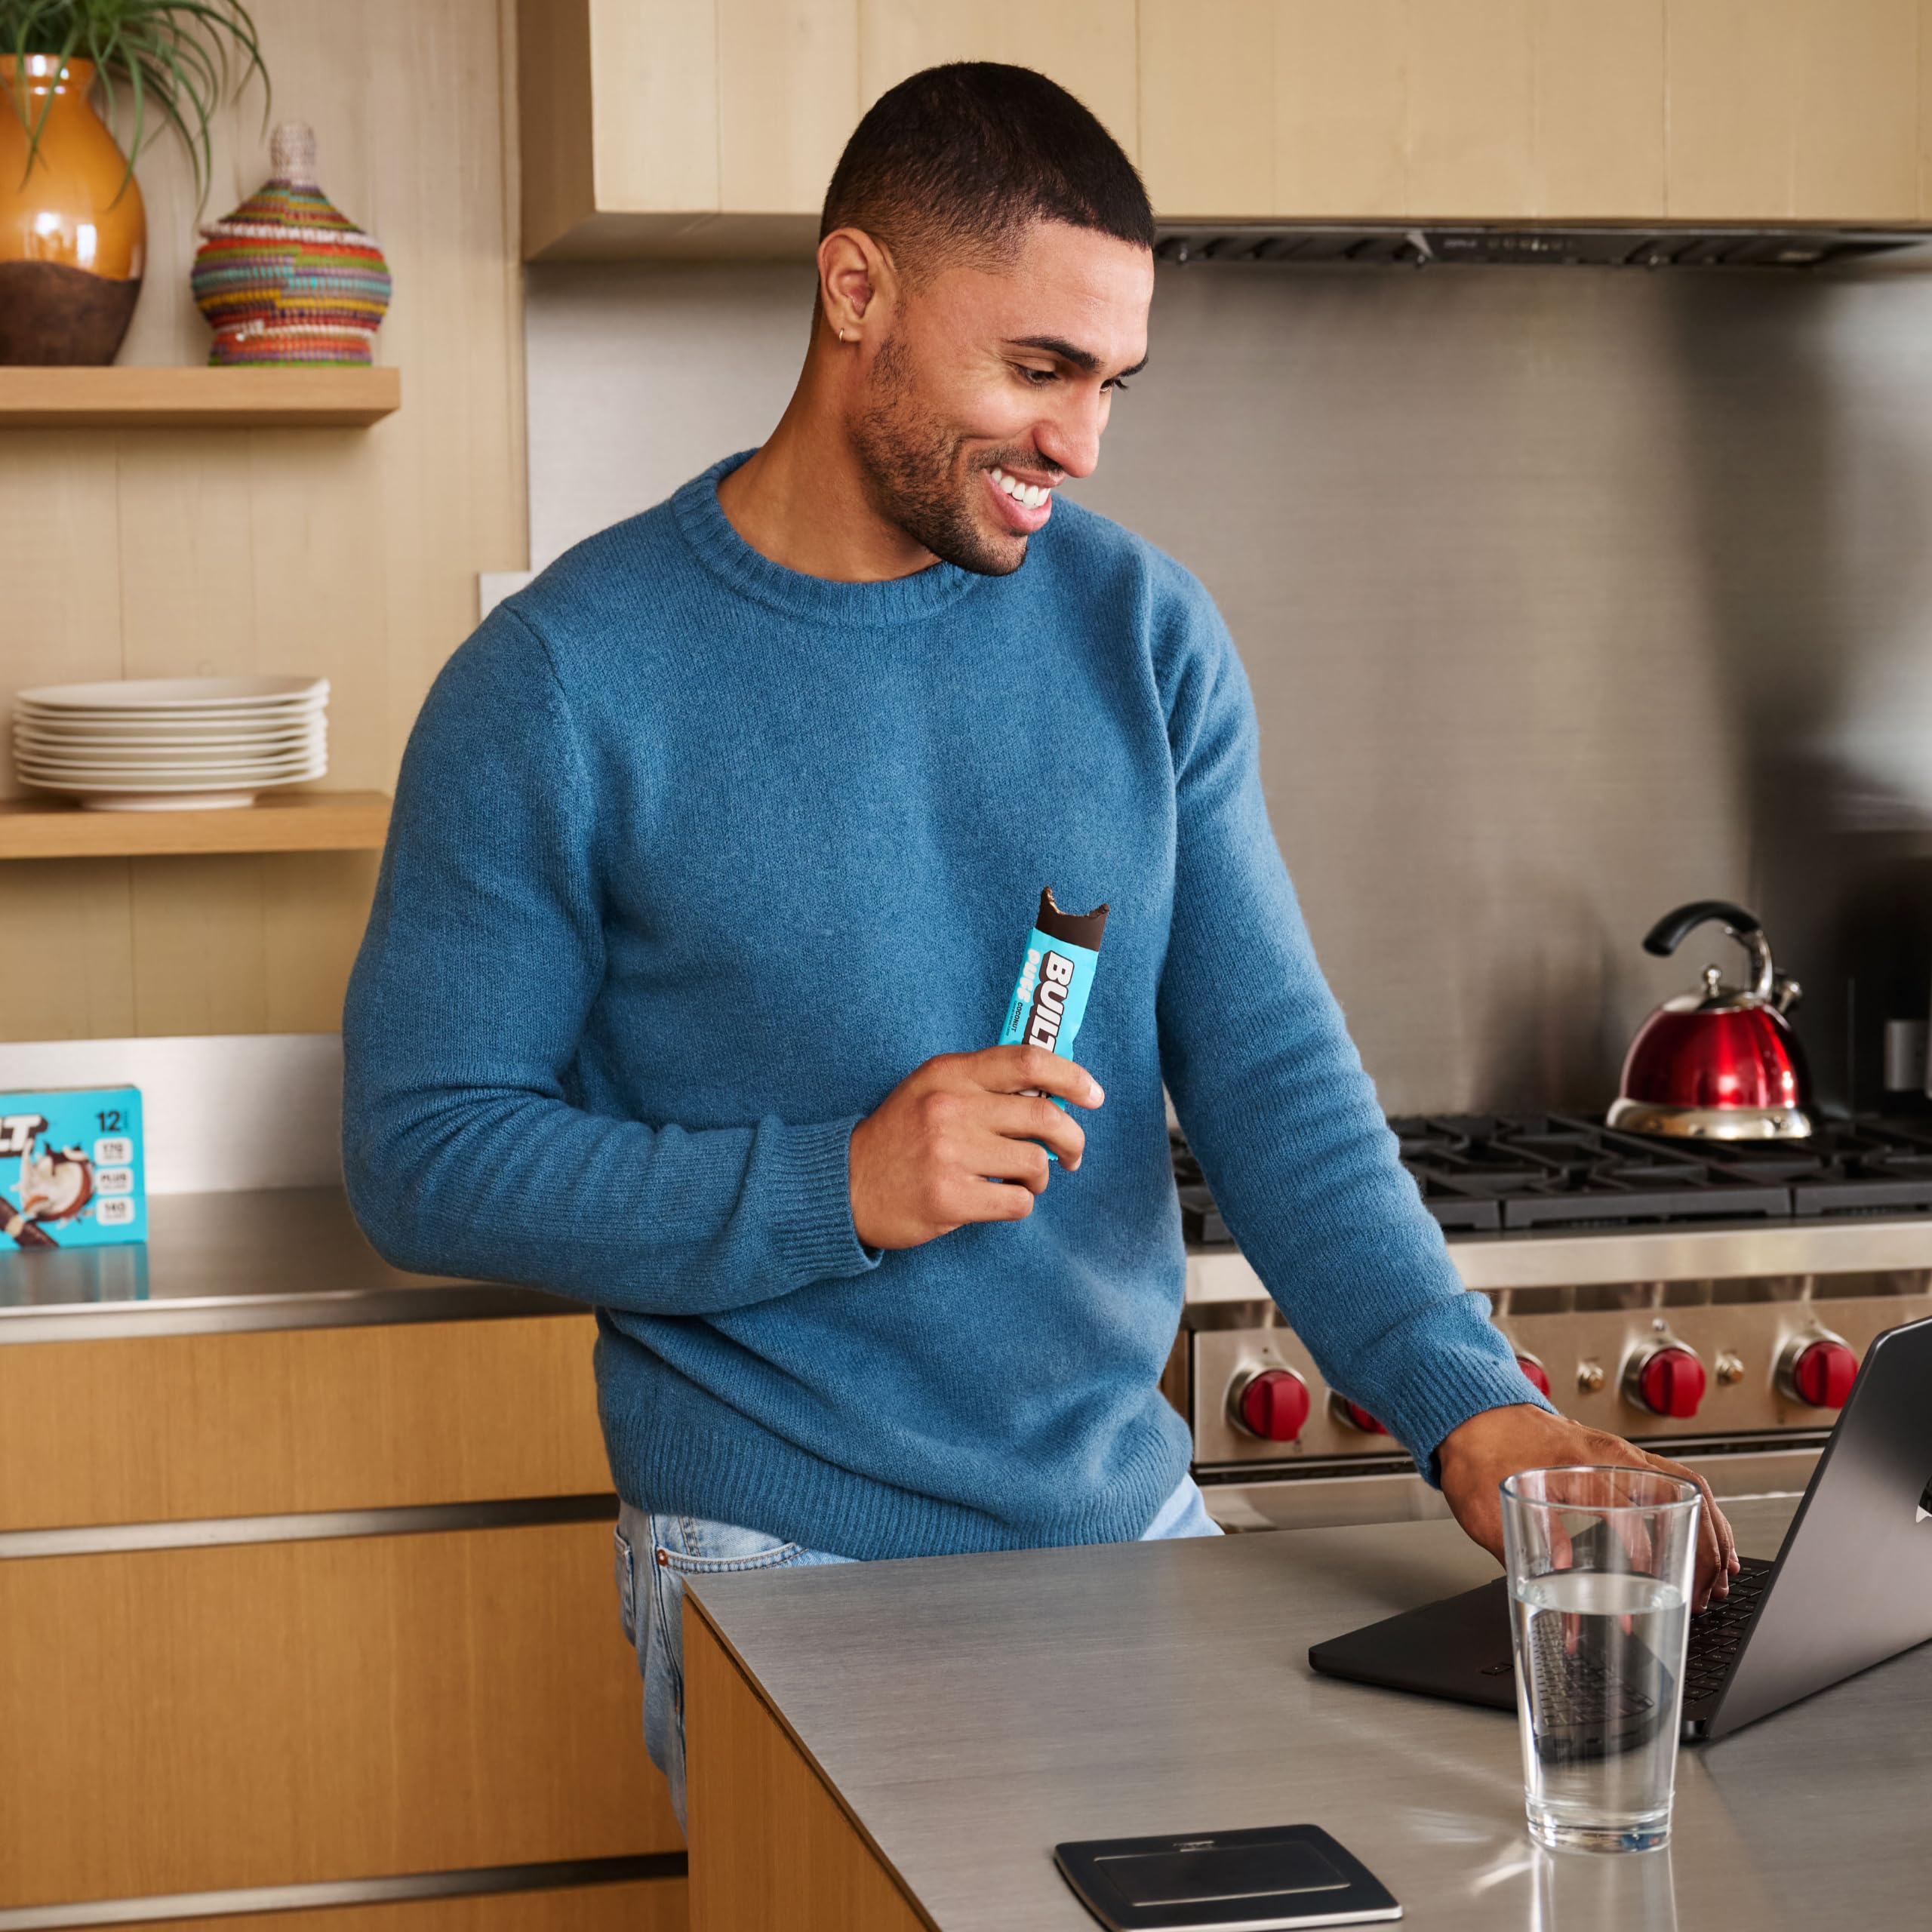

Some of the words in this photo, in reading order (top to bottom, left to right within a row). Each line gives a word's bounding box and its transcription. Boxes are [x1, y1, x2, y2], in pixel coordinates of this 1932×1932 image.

[1017, 948, 1041, 1003] PUFF
[1011, 1001, 1023, 1032] COCONUT
[96, 1110, 121, 1132] 12
[101, 1173, 126, 1183] PLUS
